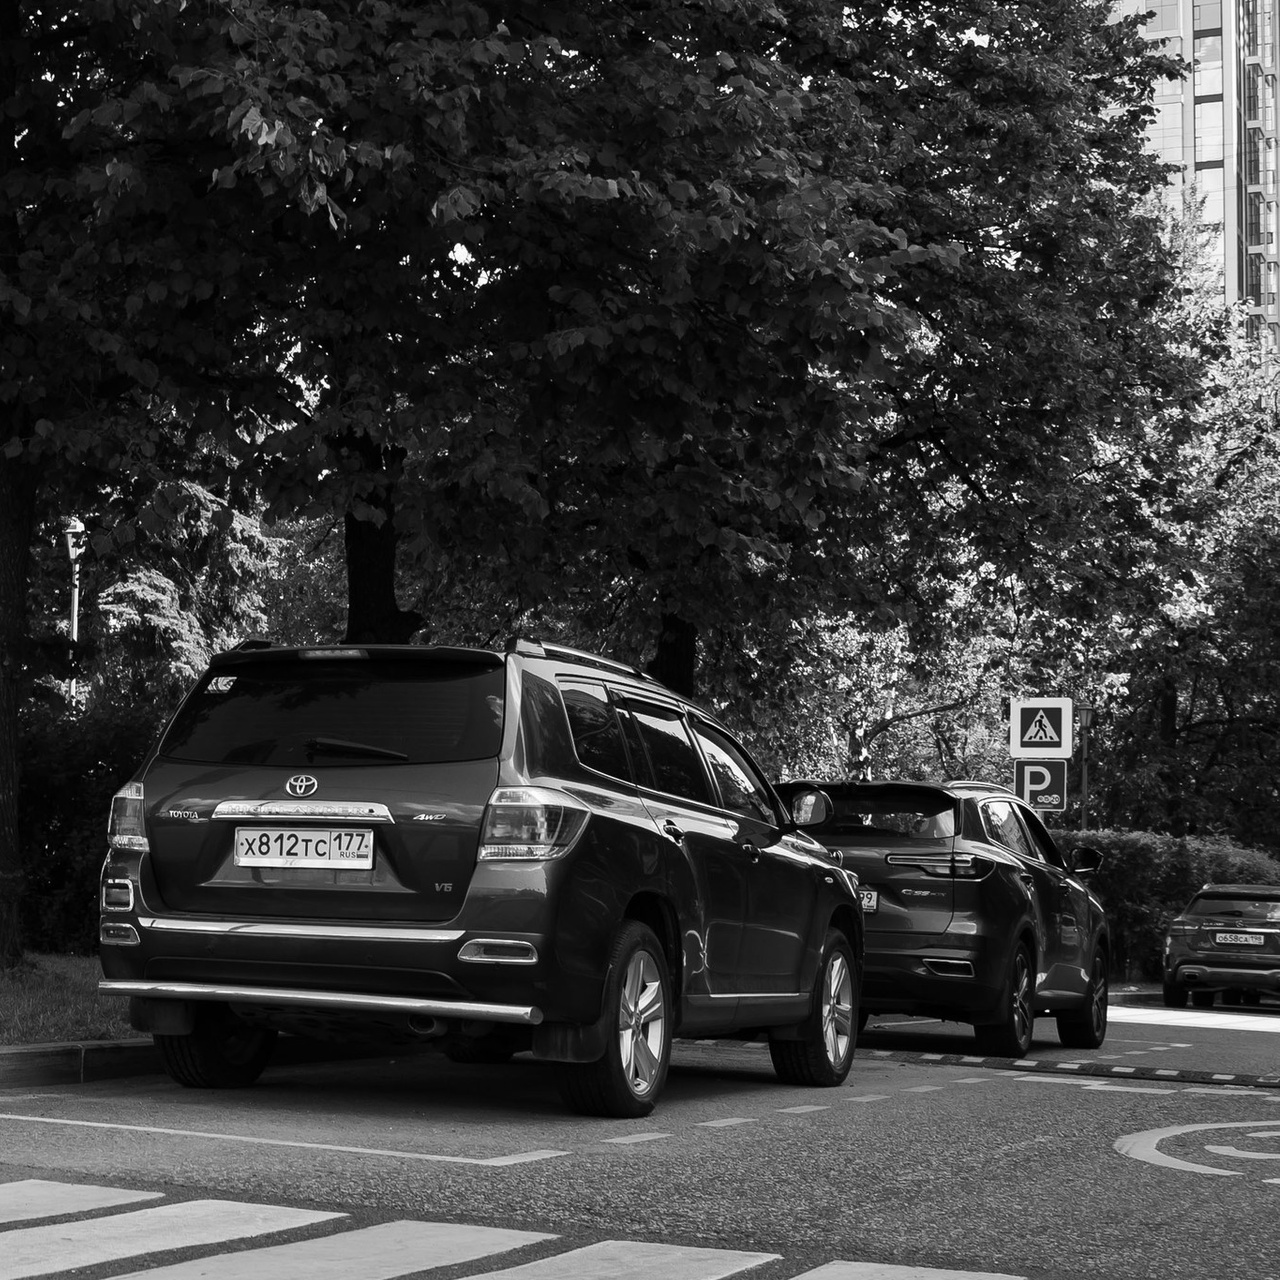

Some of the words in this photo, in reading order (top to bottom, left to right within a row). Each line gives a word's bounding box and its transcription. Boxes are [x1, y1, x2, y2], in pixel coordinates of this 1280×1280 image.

[1024, 766, 1051, 803] P
[169, 810, 199, 819] TOYOTA
[228, 805, 364, 816] HIGHLANDER
[413, 813, 447, 821] 4WD
[332, 832, 366, 851] 177
[340, 851, 356, 859] RUS
[434, 882, 453, 892] V6
